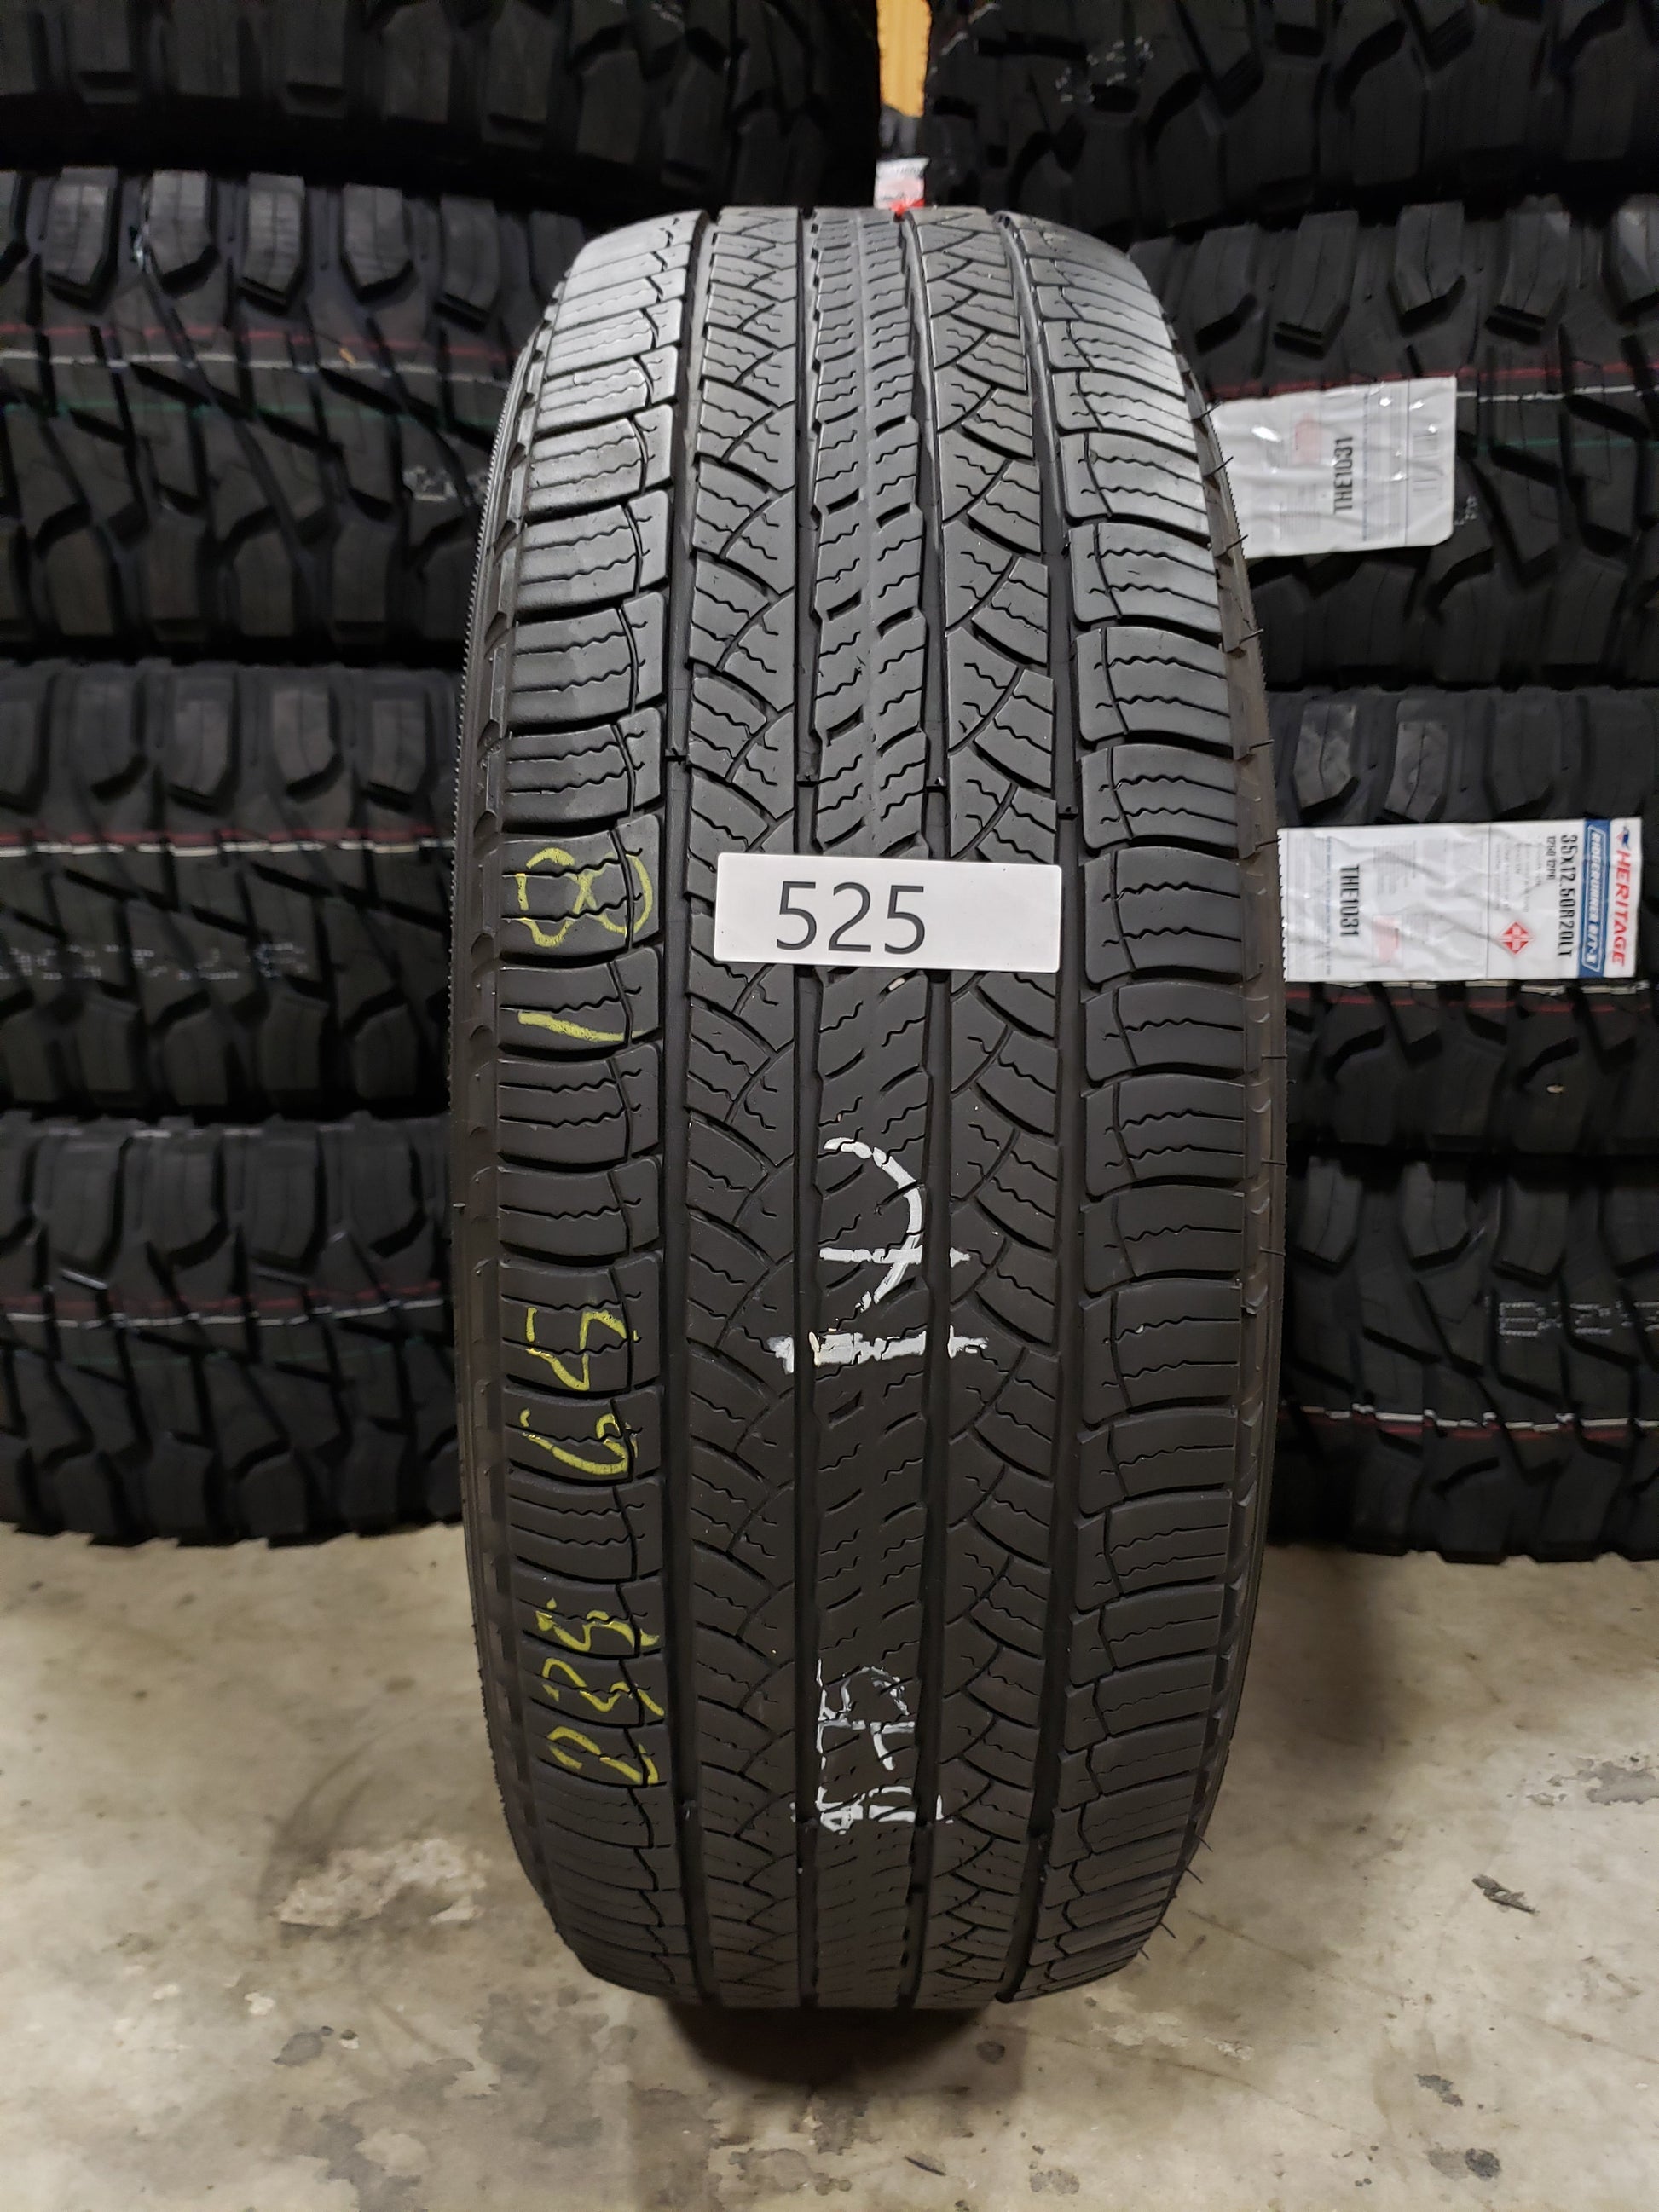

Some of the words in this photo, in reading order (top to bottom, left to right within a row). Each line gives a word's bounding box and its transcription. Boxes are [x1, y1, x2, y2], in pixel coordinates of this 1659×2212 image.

[1334, 436, 1354, 514] THE1031
[775, 880, 926, 955] 525
[1340, 863, 1361, 937] THE1031
[1612, 850, 1632, 967] HERITAGE
[519, 1306, 639, 1476] 65
